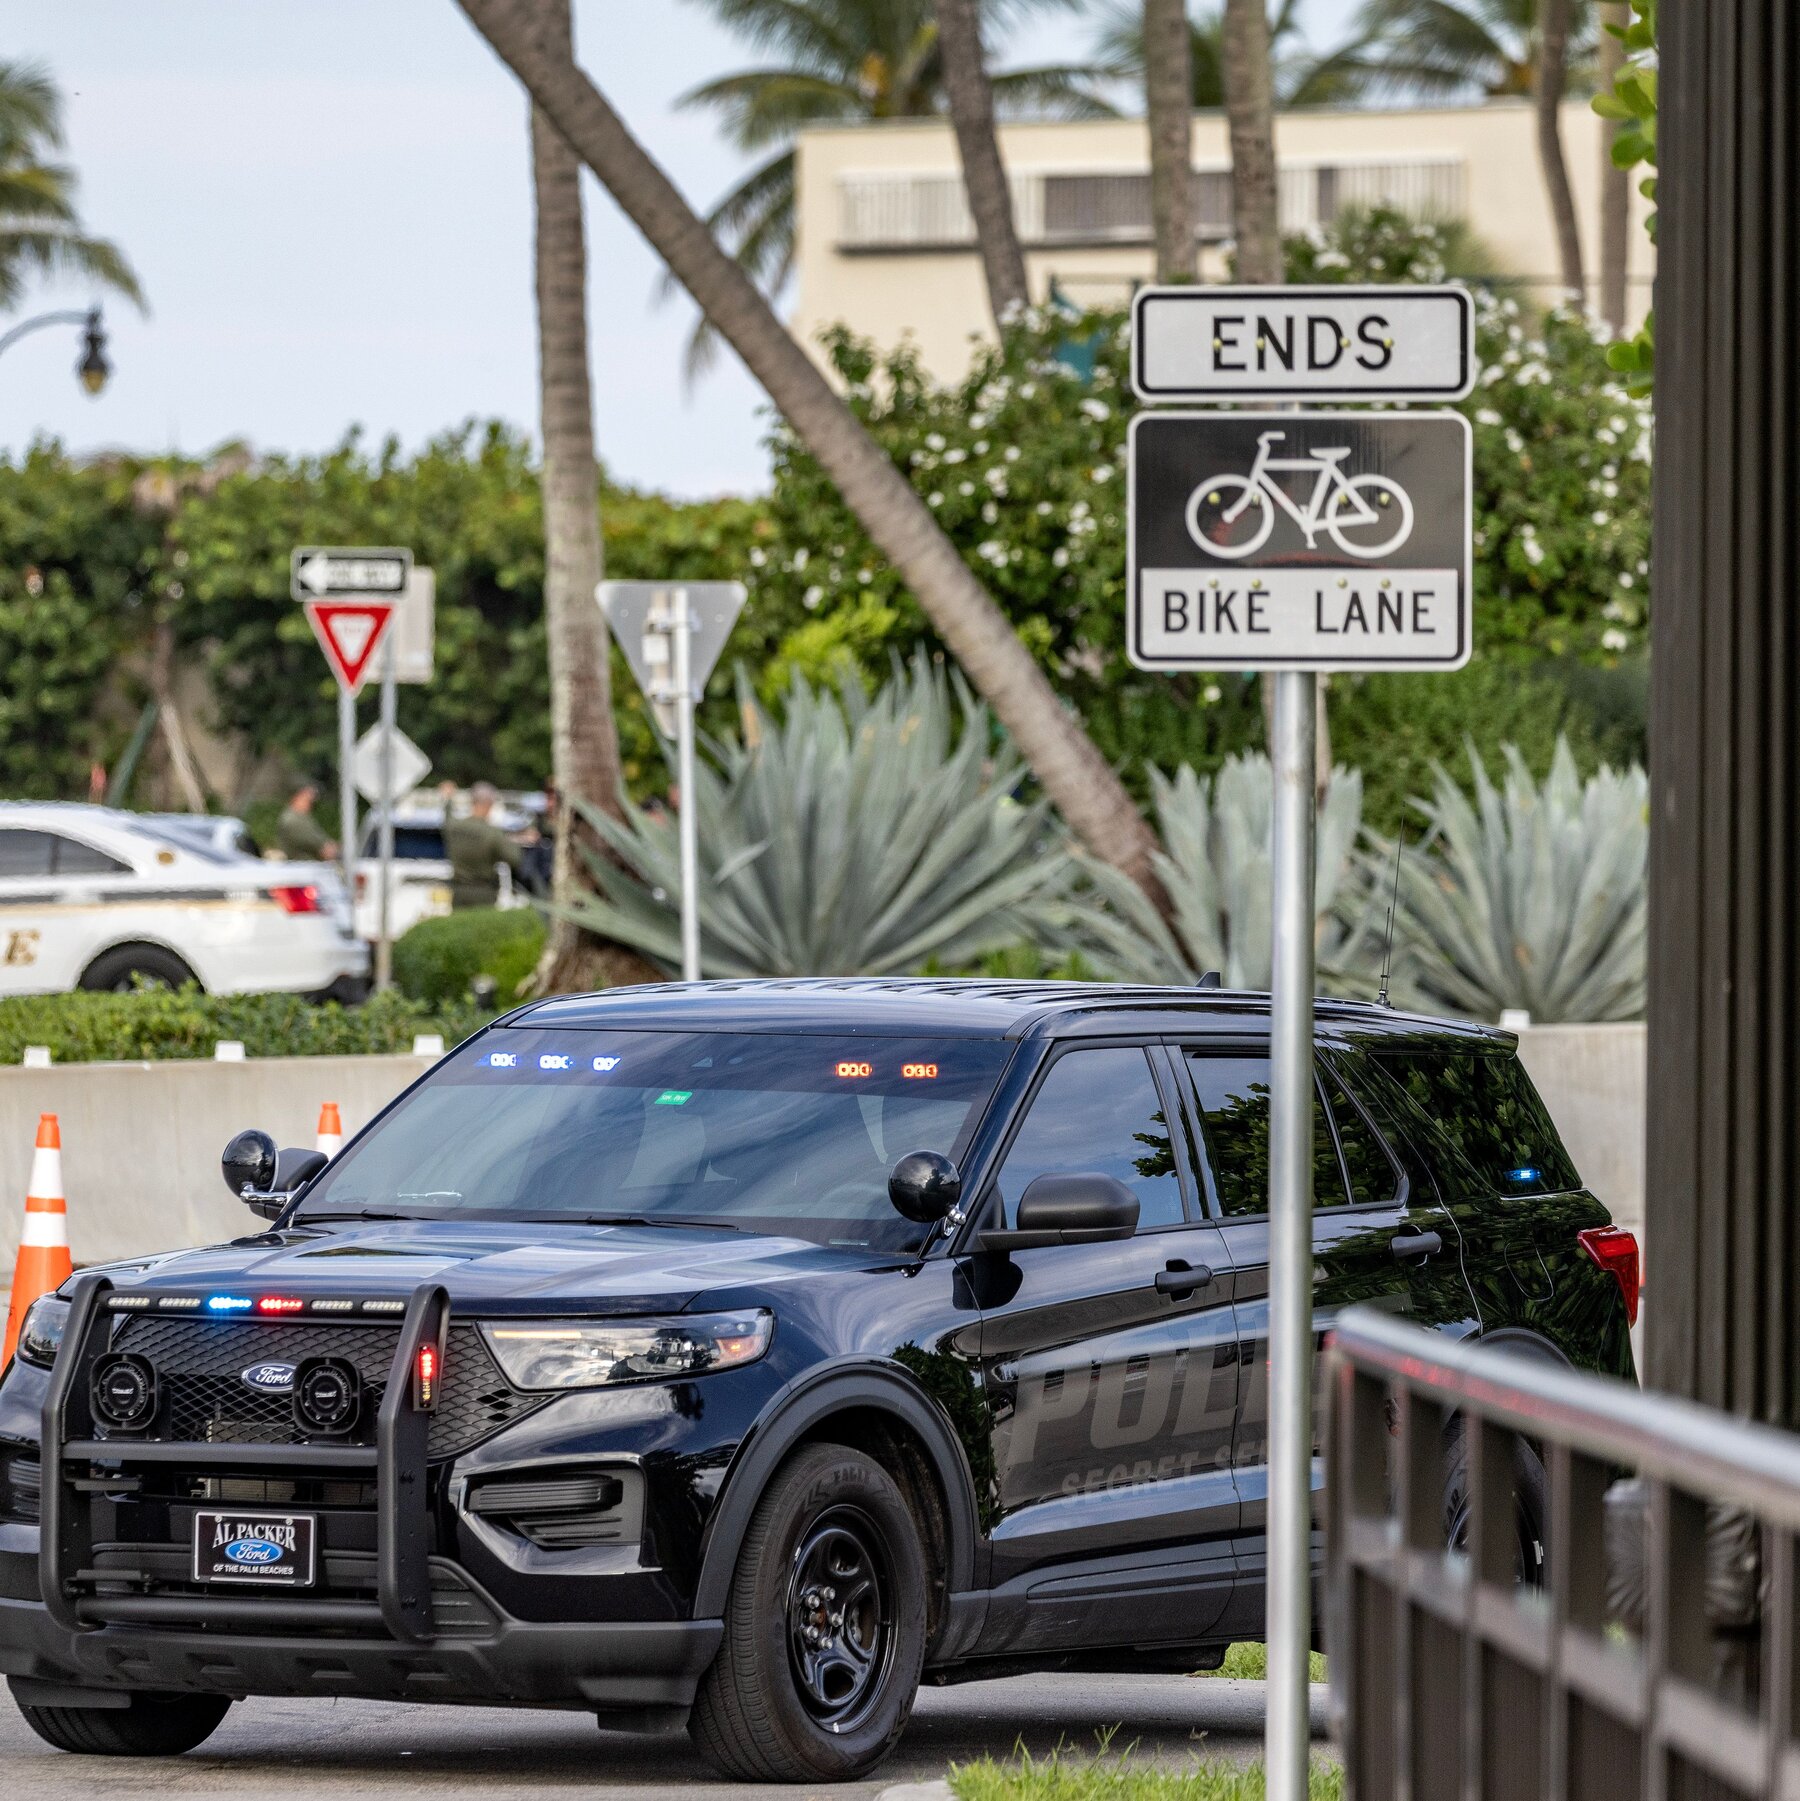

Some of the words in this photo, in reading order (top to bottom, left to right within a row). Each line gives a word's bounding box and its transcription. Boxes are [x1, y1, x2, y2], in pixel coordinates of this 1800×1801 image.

[1212, 314, 1393, 372] ENDS
[1163, 590, 1271, 634] BIKE
[1315, 590, 1436, 634] LANE
[255, 1366, 293, 1385] Ford
[1007, 1320, 1268, 1466] POLI
[1062, 1452, 1201, 1499] SECRET
[212, 1522, 235, 1549] AL
[236, 1523, 297, 1552] PACKER
[236, 1543, 272, 1562] Ford
[213, 1564, 224, 1573] OF
[225, 1564, 239, 1574] THE
[239, 1565, 259, 1575] PALM
[259, 1565, 294, 1576] BEACHES
